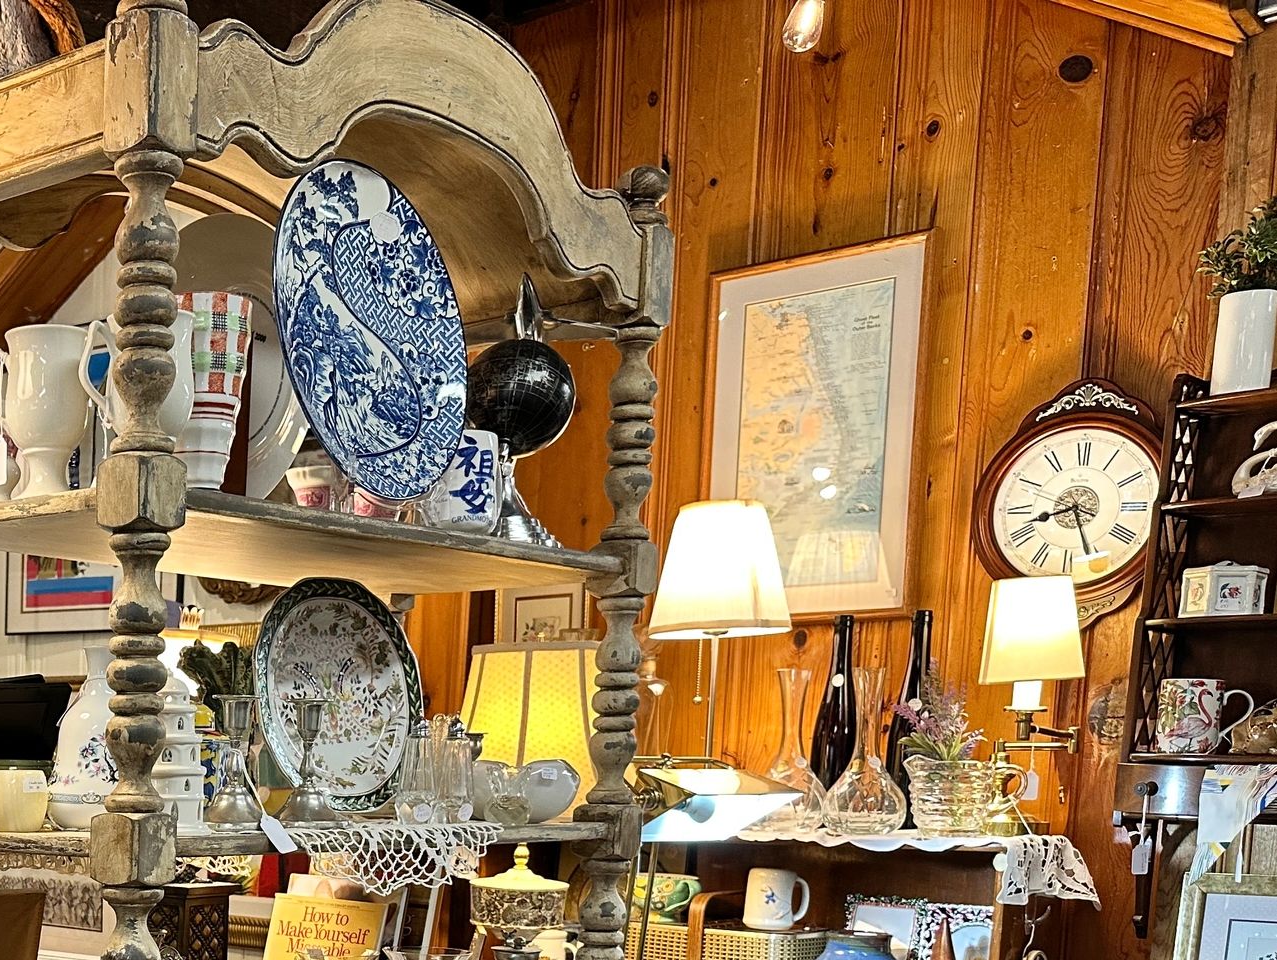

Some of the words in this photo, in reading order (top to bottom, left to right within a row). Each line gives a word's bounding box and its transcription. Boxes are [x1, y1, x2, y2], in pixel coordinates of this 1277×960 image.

[302, 906, 335, 923] How
[335, 911, 350, 926] to
[276, 920, 313, 939] Make
[313, 923, 371, 945] Yourself
